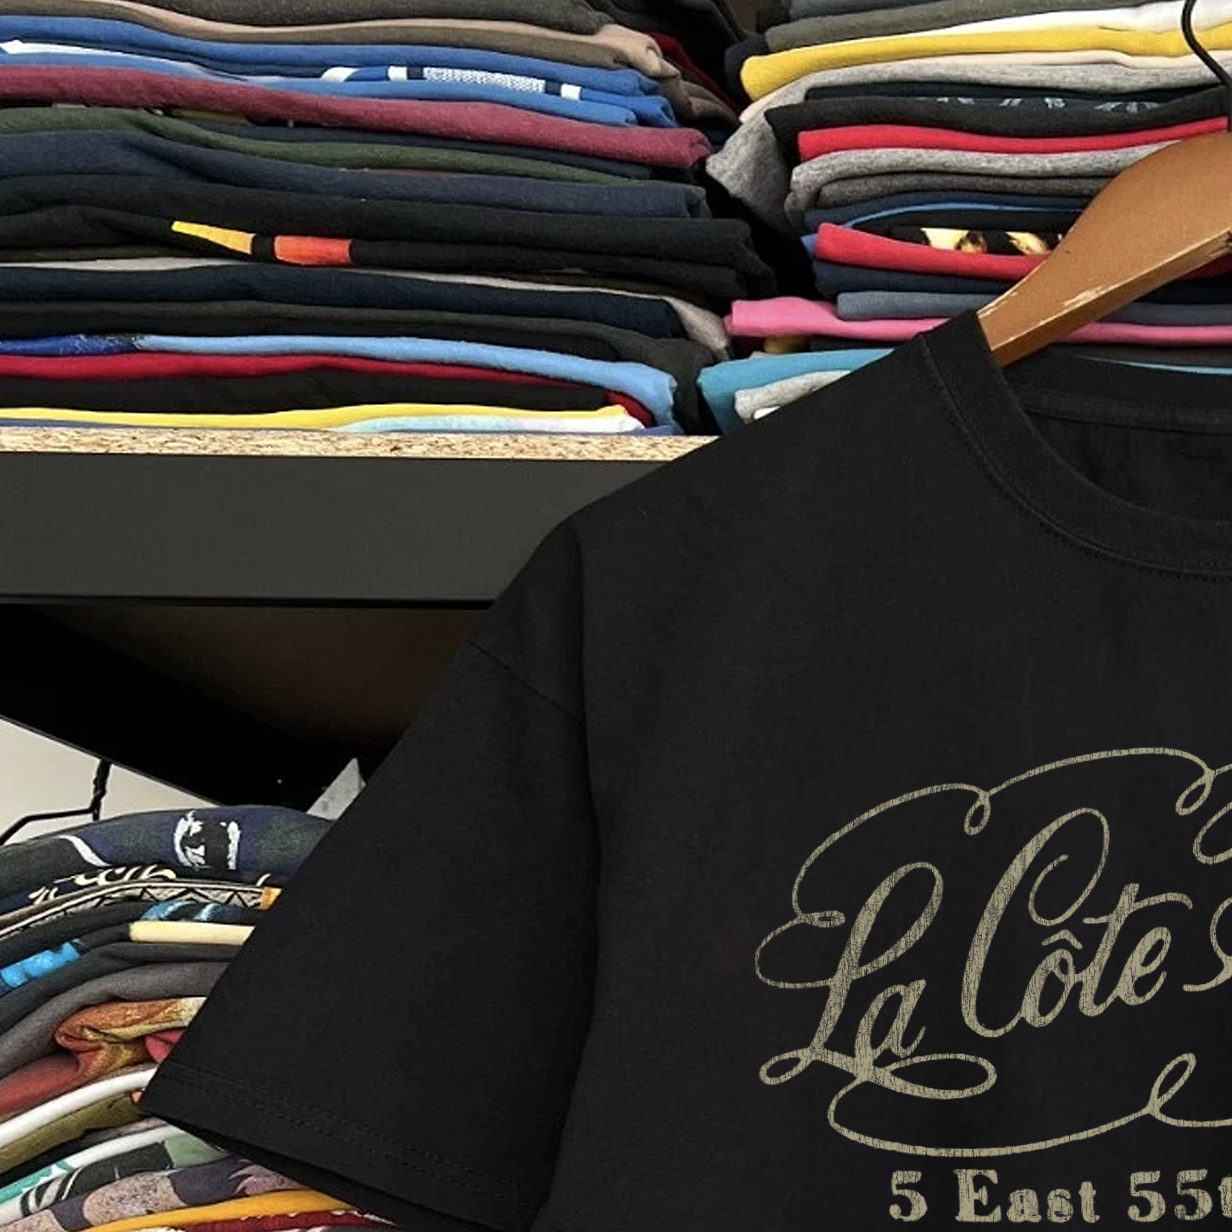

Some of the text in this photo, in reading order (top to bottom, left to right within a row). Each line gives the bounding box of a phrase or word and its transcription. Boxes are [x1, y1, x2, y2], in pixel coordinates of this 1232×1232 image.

[755, 861, 998, 1100] La
[960, 806, 1194, 1038] Côte
[888, 1169, 928, 1222] 5
[953, 1168, 1101, 1224] East
